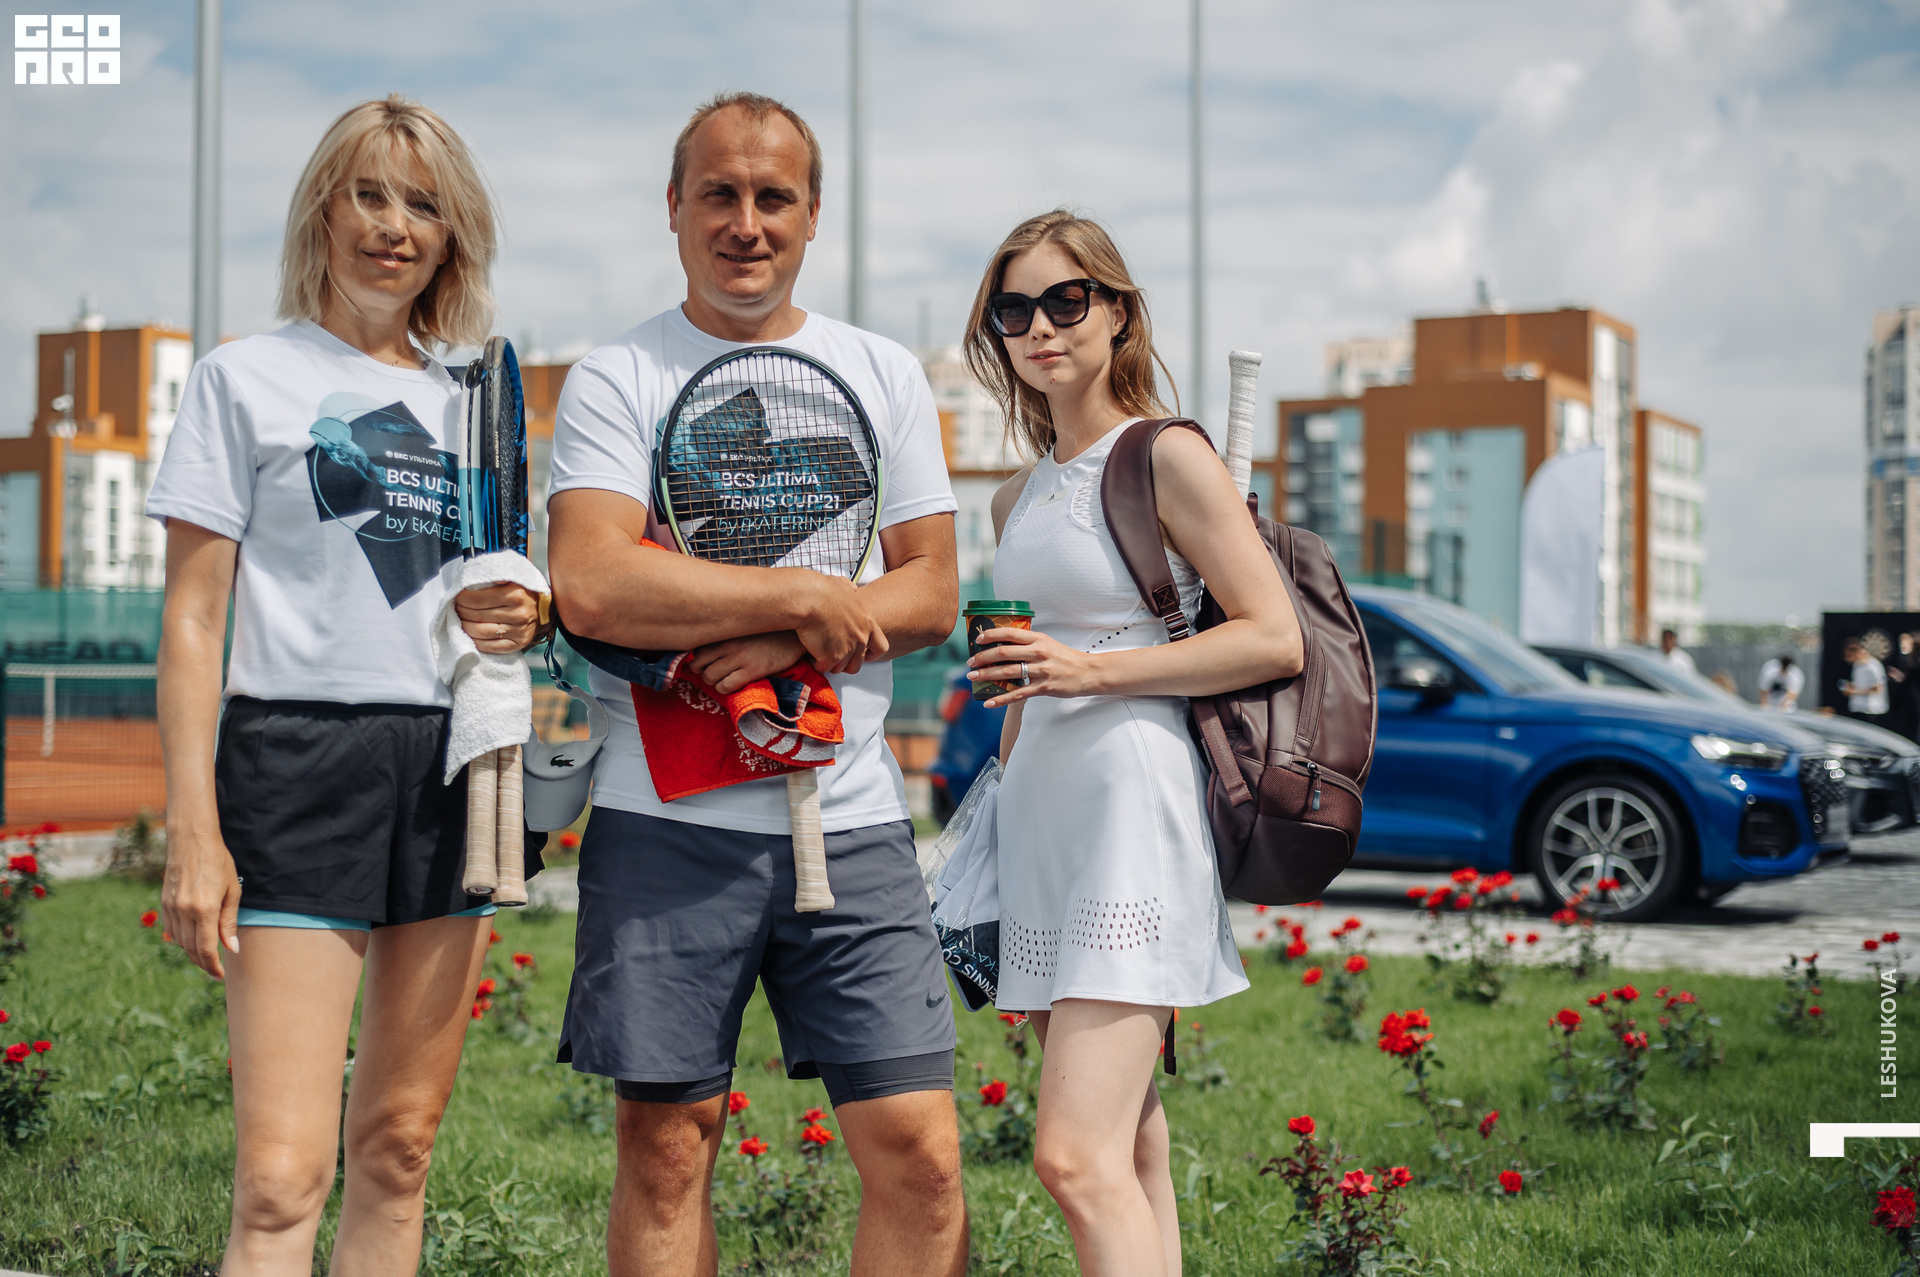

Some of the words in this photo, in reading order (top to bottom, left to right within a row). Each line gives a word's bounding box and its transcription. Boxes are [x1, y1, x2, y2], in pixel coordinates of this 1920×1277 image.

[387, 469, 421, 487] BCS
[722, 472, 756, 488] BCS
[385, 491, 443, 516] TENNIS
[720, 493, 777, 510] TENNIS
[386, 514, 408, 533] by
[719, 518, 738, 536] by
